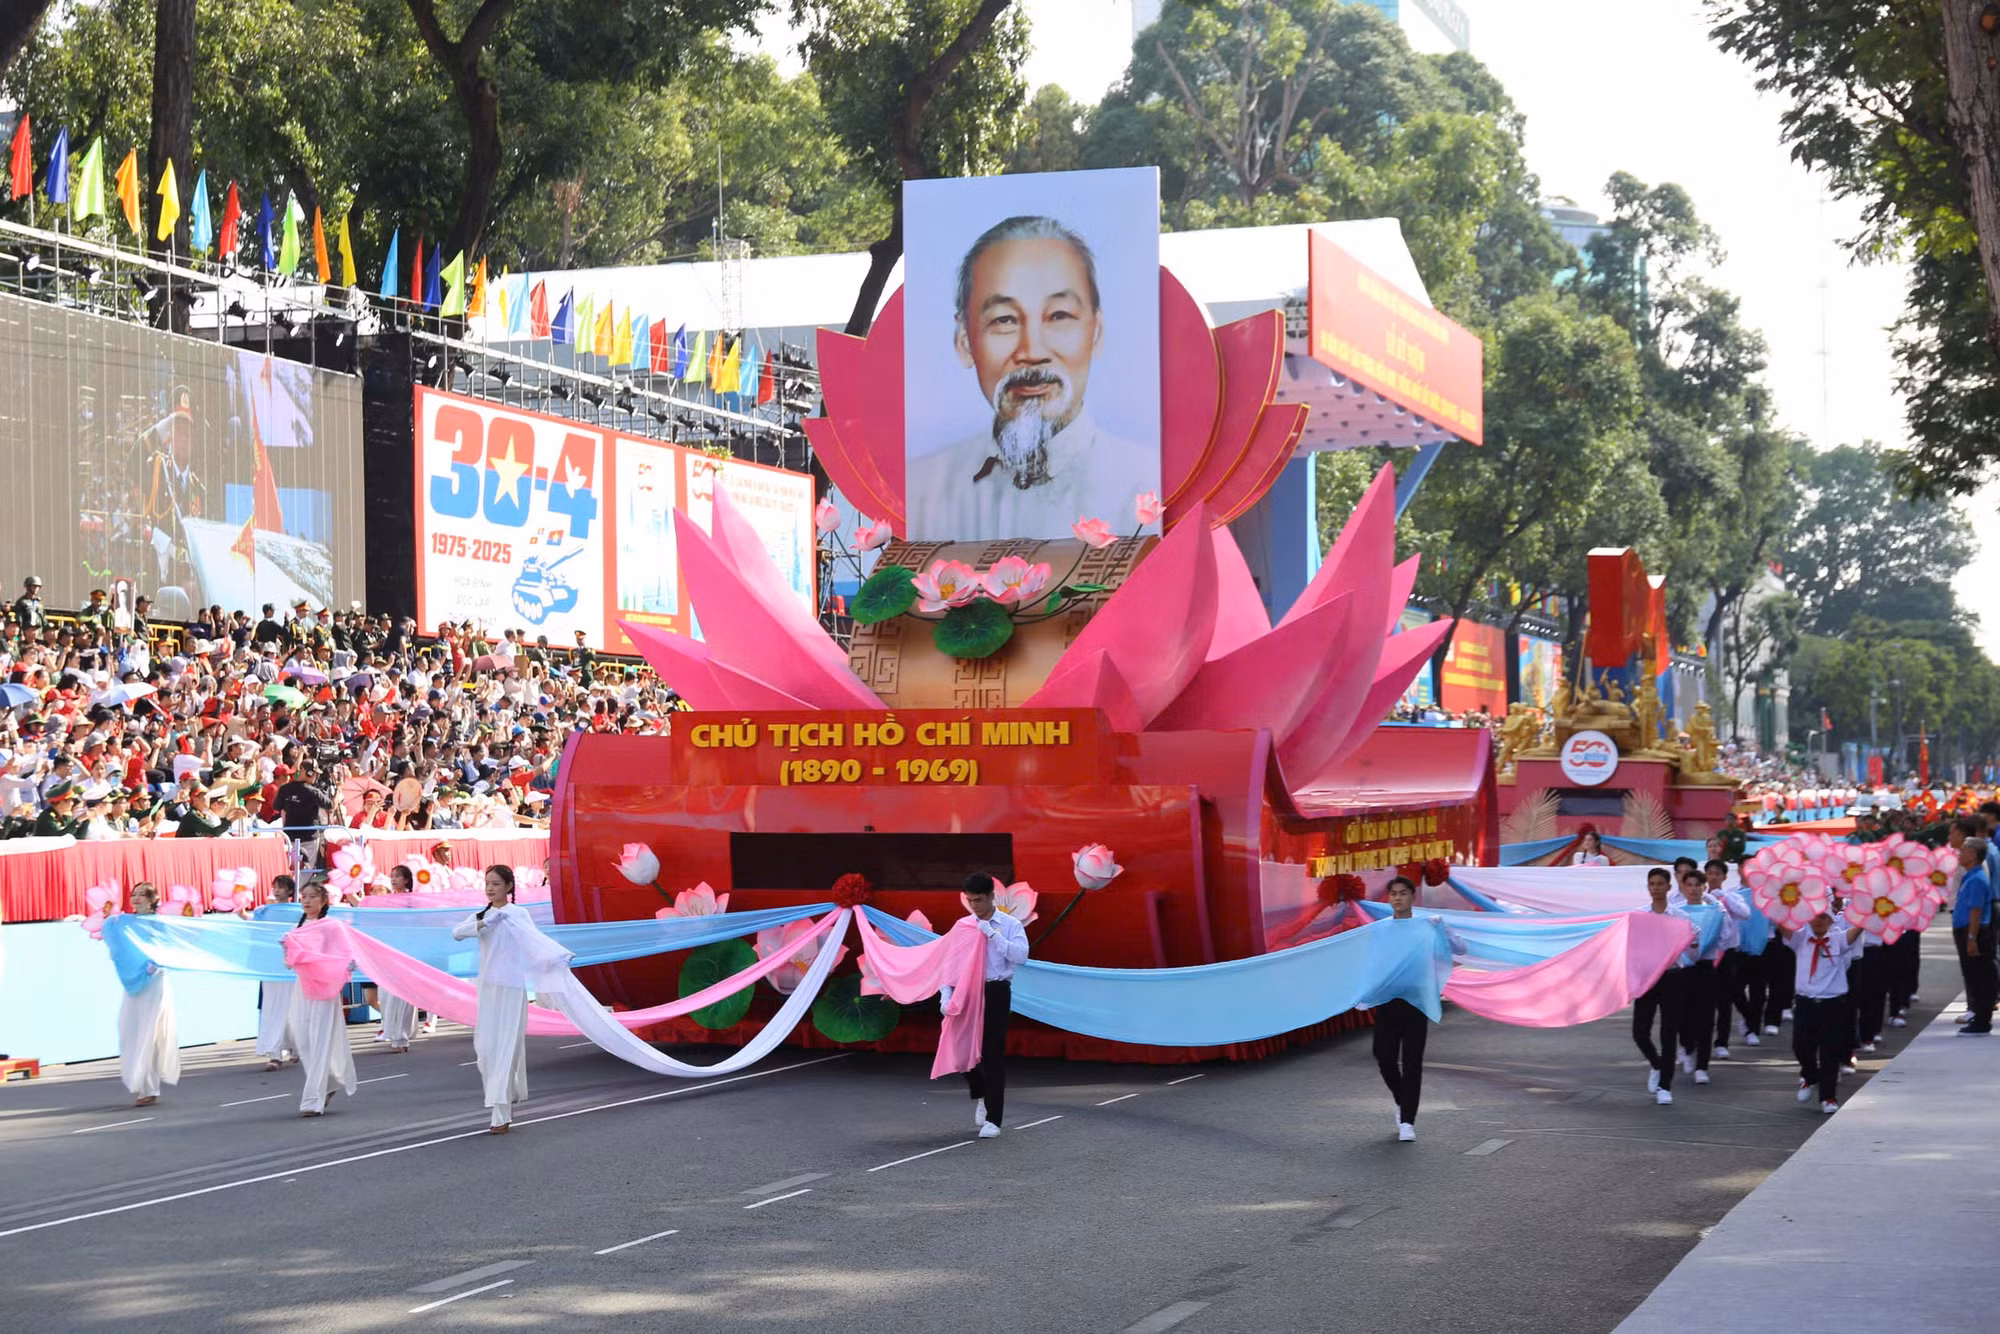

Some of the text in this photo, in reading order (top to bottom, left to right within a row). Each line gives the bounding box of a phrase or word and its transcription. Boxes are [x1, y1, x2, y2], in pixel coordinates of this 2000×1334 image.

[430, 404, 597, 539] 30-4
[691, 713, 1070, 752] CHỦ TỊCH HỒ CHÍ MINH
[780, 758, 978, 787] (1890 - 1969)
